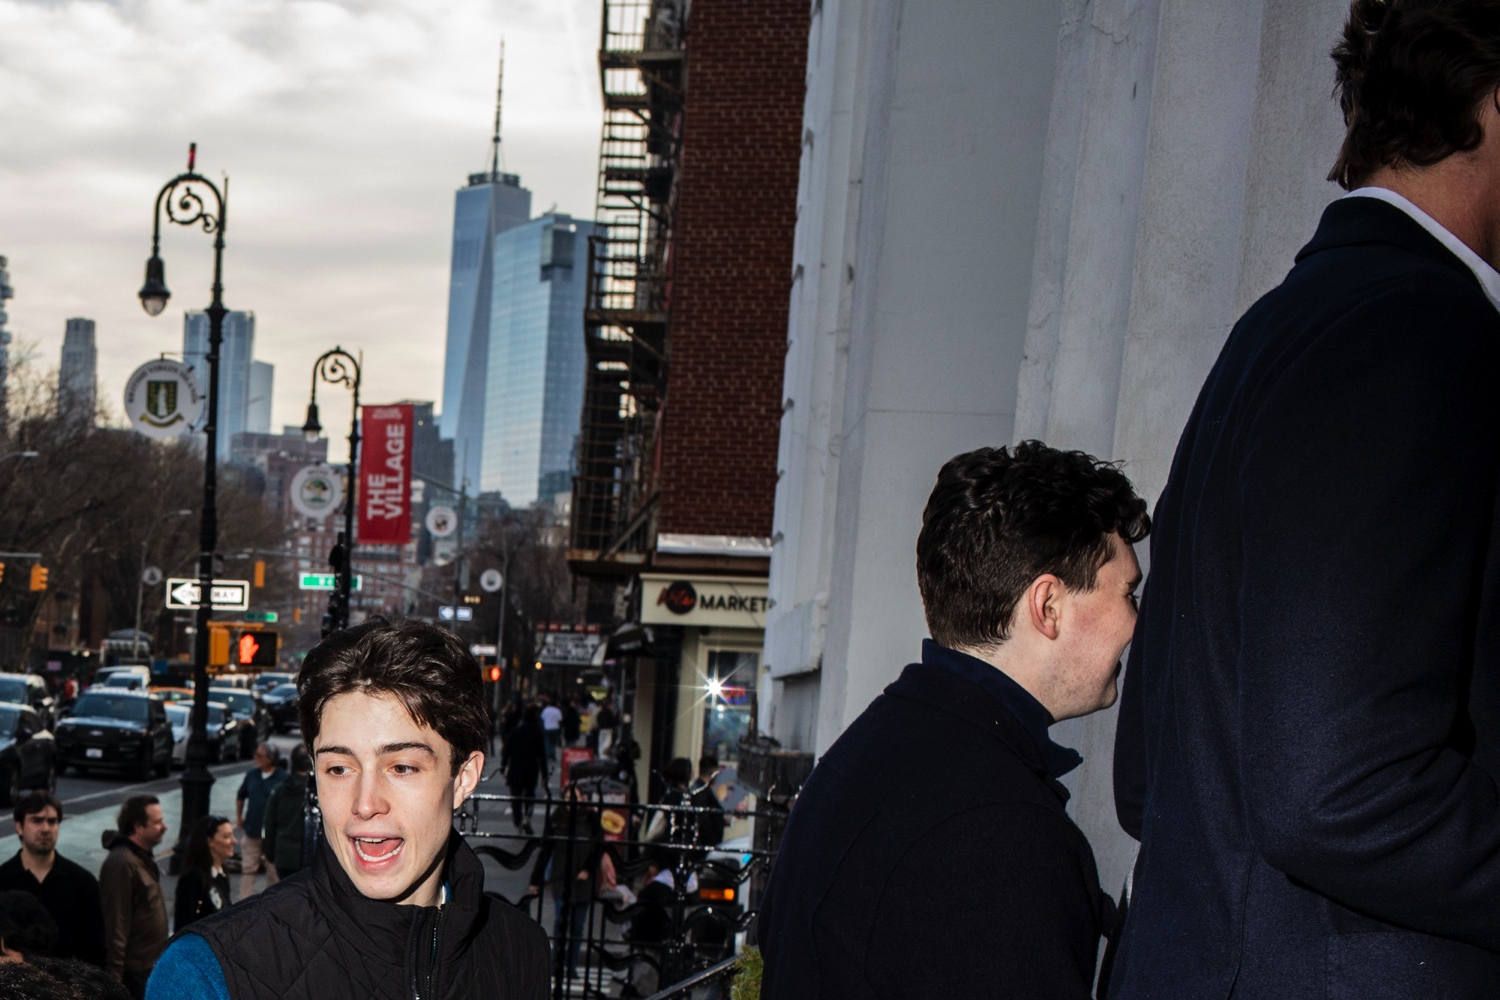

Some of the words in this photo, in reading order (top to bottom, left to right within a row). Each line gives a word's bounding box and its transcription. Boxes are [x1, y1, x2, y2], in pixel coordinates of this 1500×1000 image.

[384, 423, 406, 520] VILLAGE
[367, 473, 386, 520] THE
[699, 594, 767, 613] MARKET
